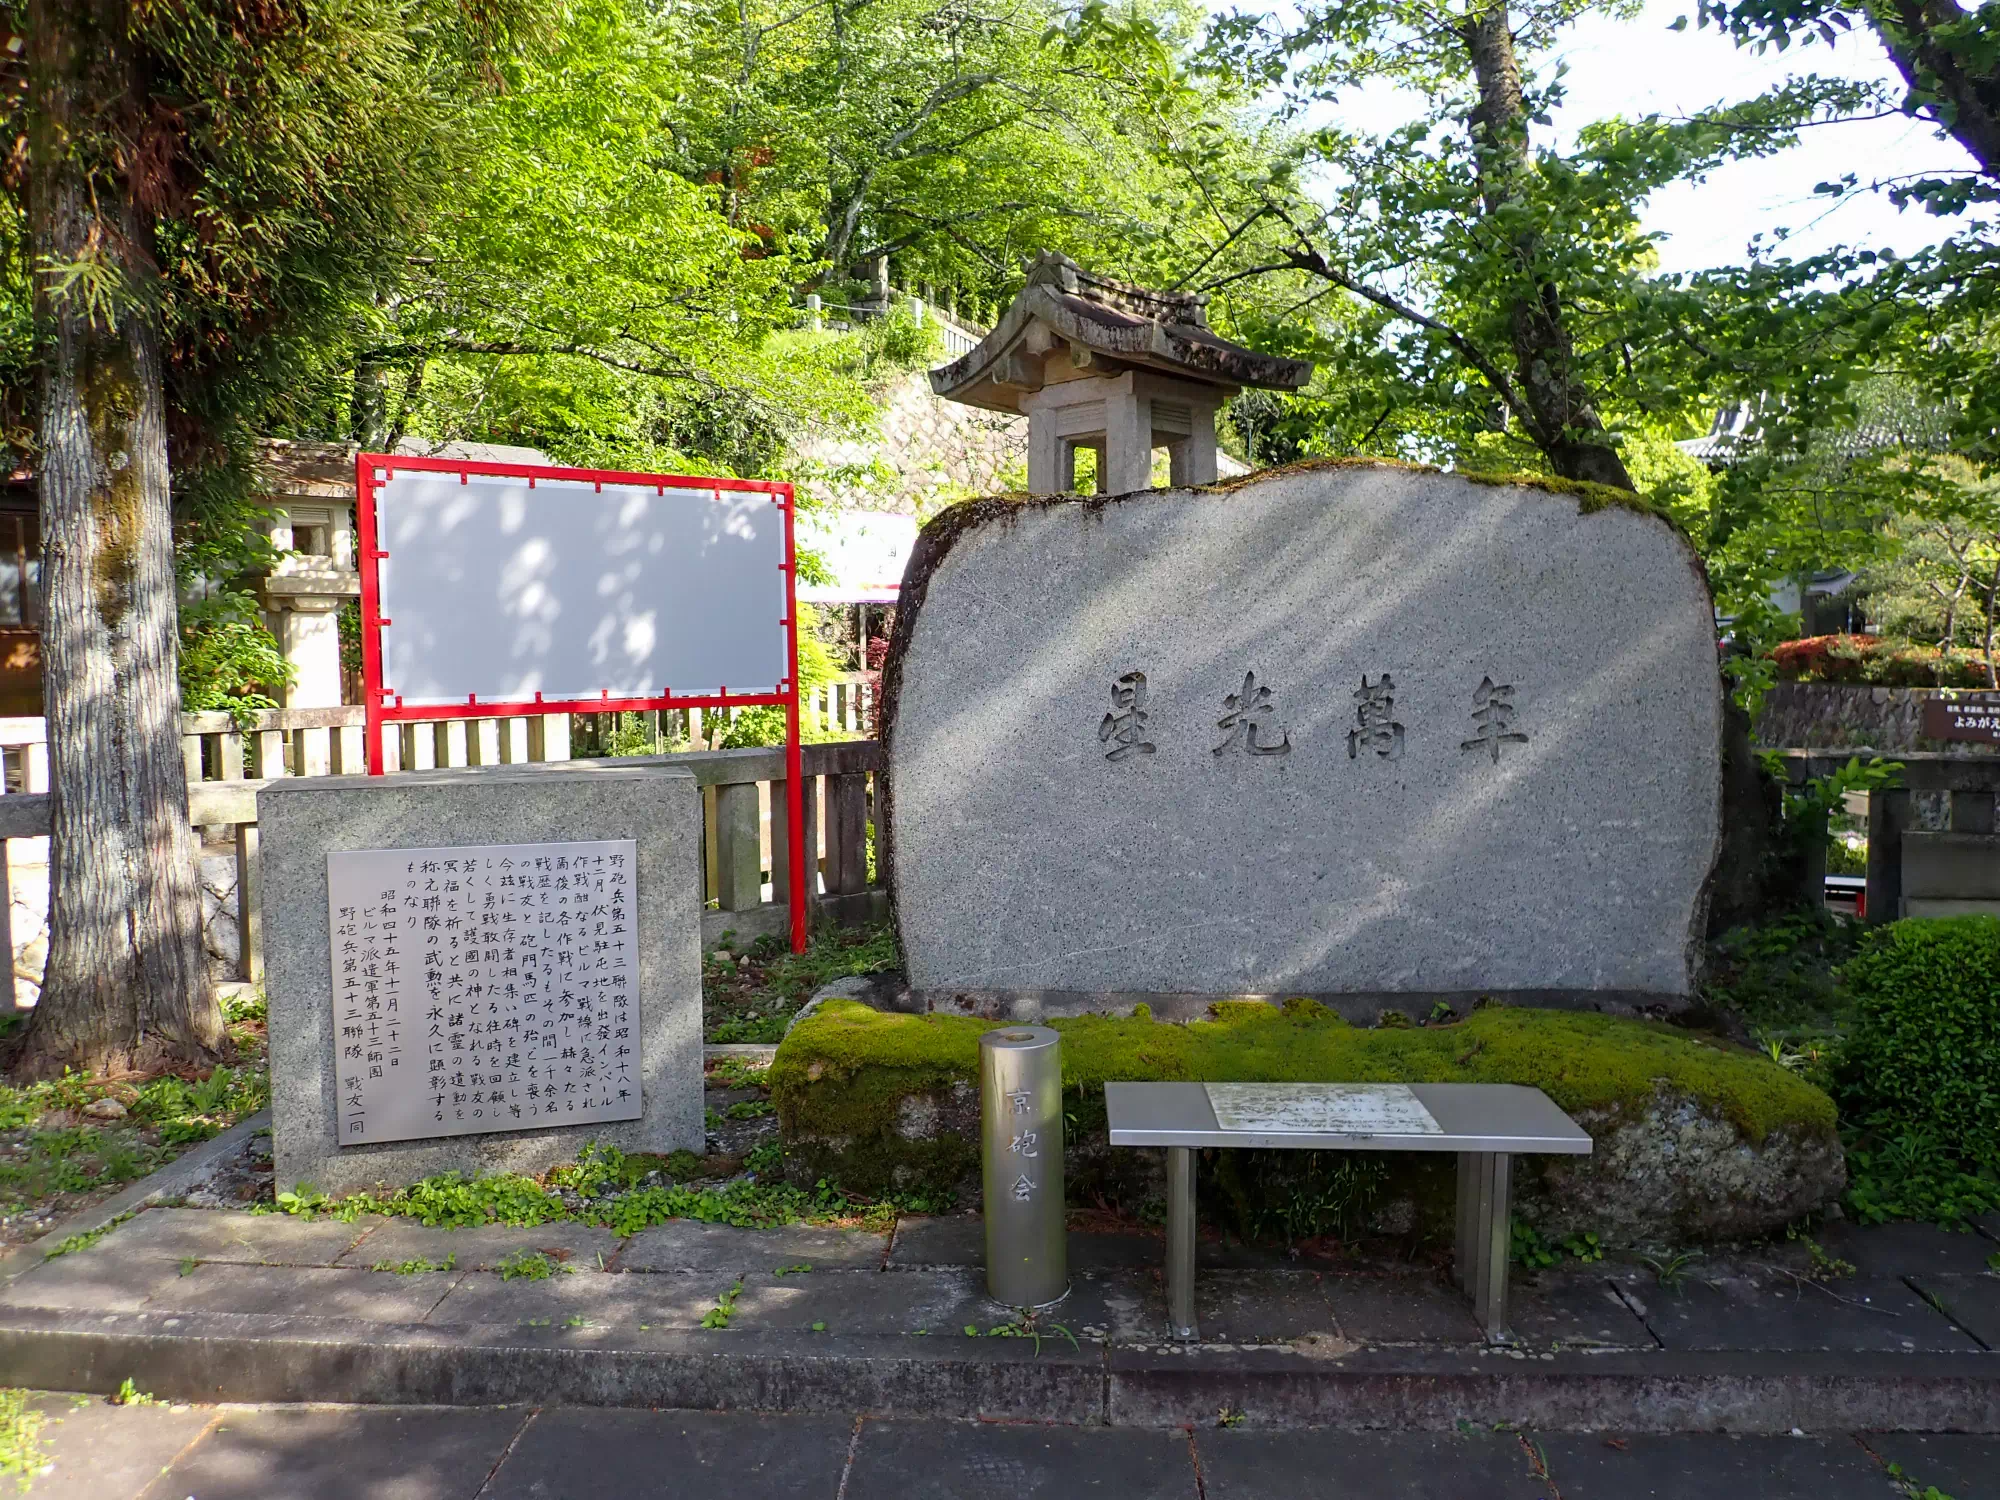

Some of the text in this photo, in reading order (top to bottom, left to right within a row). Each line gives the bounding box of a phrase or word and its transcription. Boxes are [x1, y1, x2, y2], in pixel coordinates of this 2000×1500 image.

[1098, 670, 1530, 765] 星光萬年
[404, 860, 421, 930] ものなり
[379, 889, 402, 1067] 昭和四十五年十一月二十二日
[1006, 1088, 1038, 1202] 京砲会
